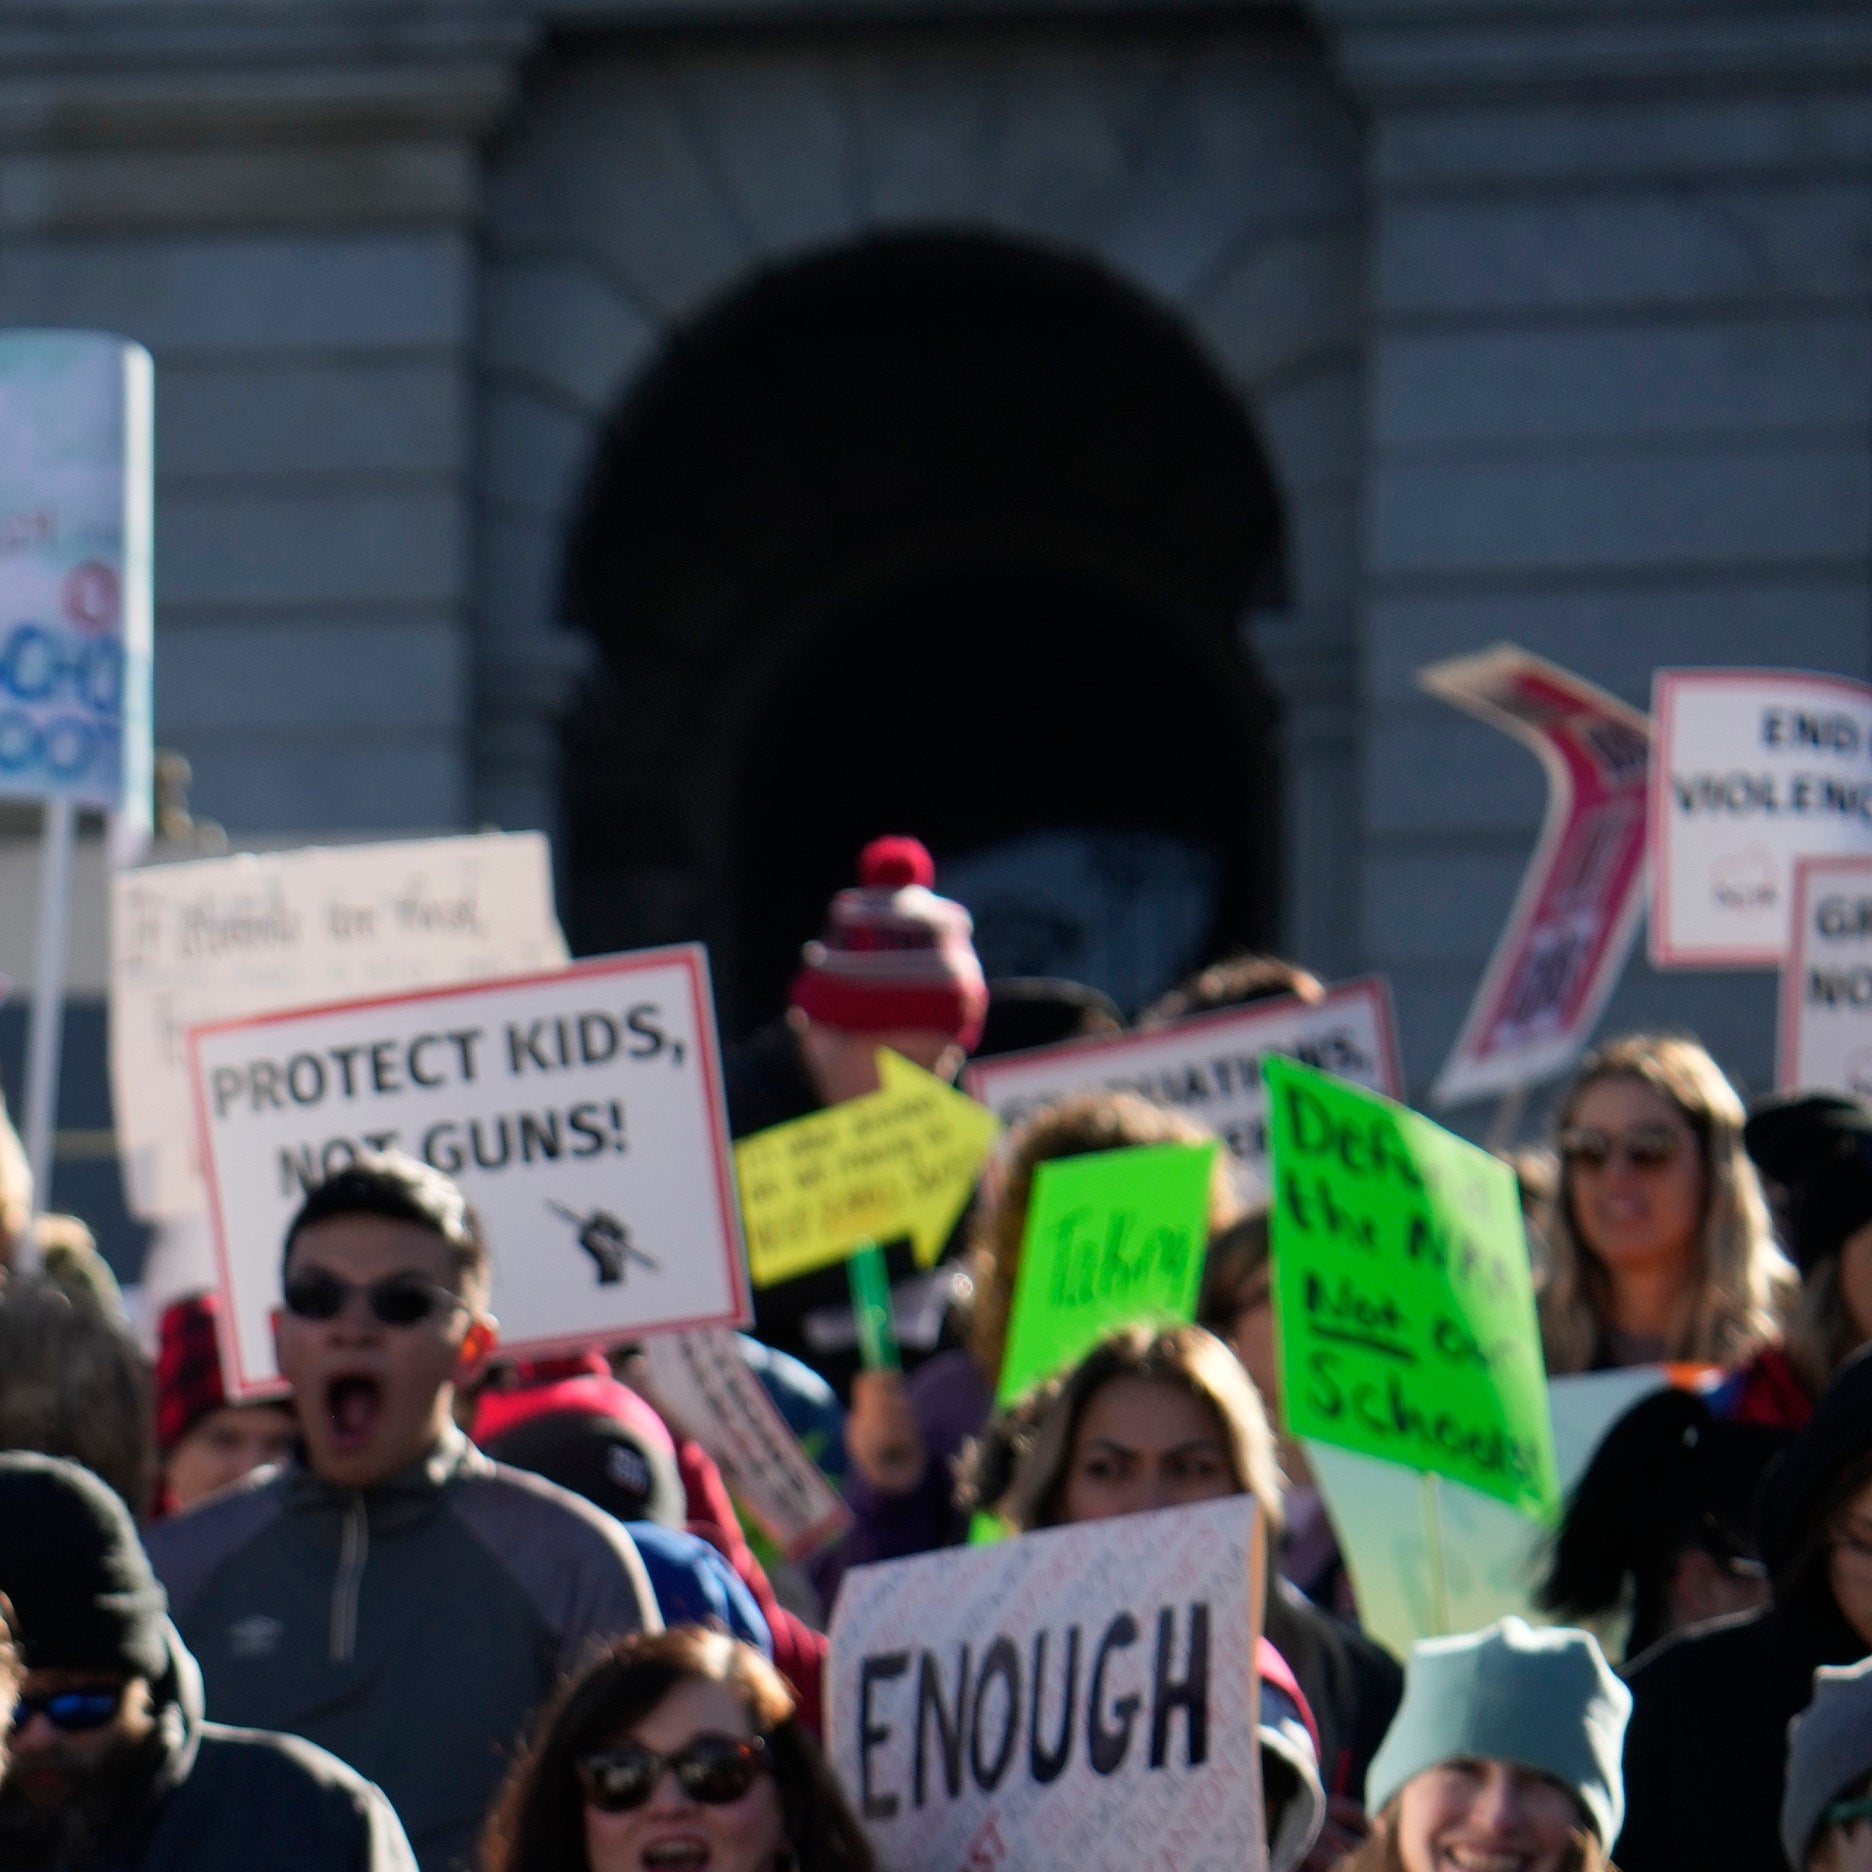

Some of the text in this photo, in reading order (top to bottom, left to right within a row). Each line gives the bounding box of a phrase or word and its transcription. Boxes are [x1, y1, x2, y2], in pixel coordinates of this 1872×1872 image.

[210, 1003, 687, 1117] PROTECT KIDS,
[420, 1102, 626, 1177] GUNS!
[860, 1603, 1209, 1821] ENOUGH
